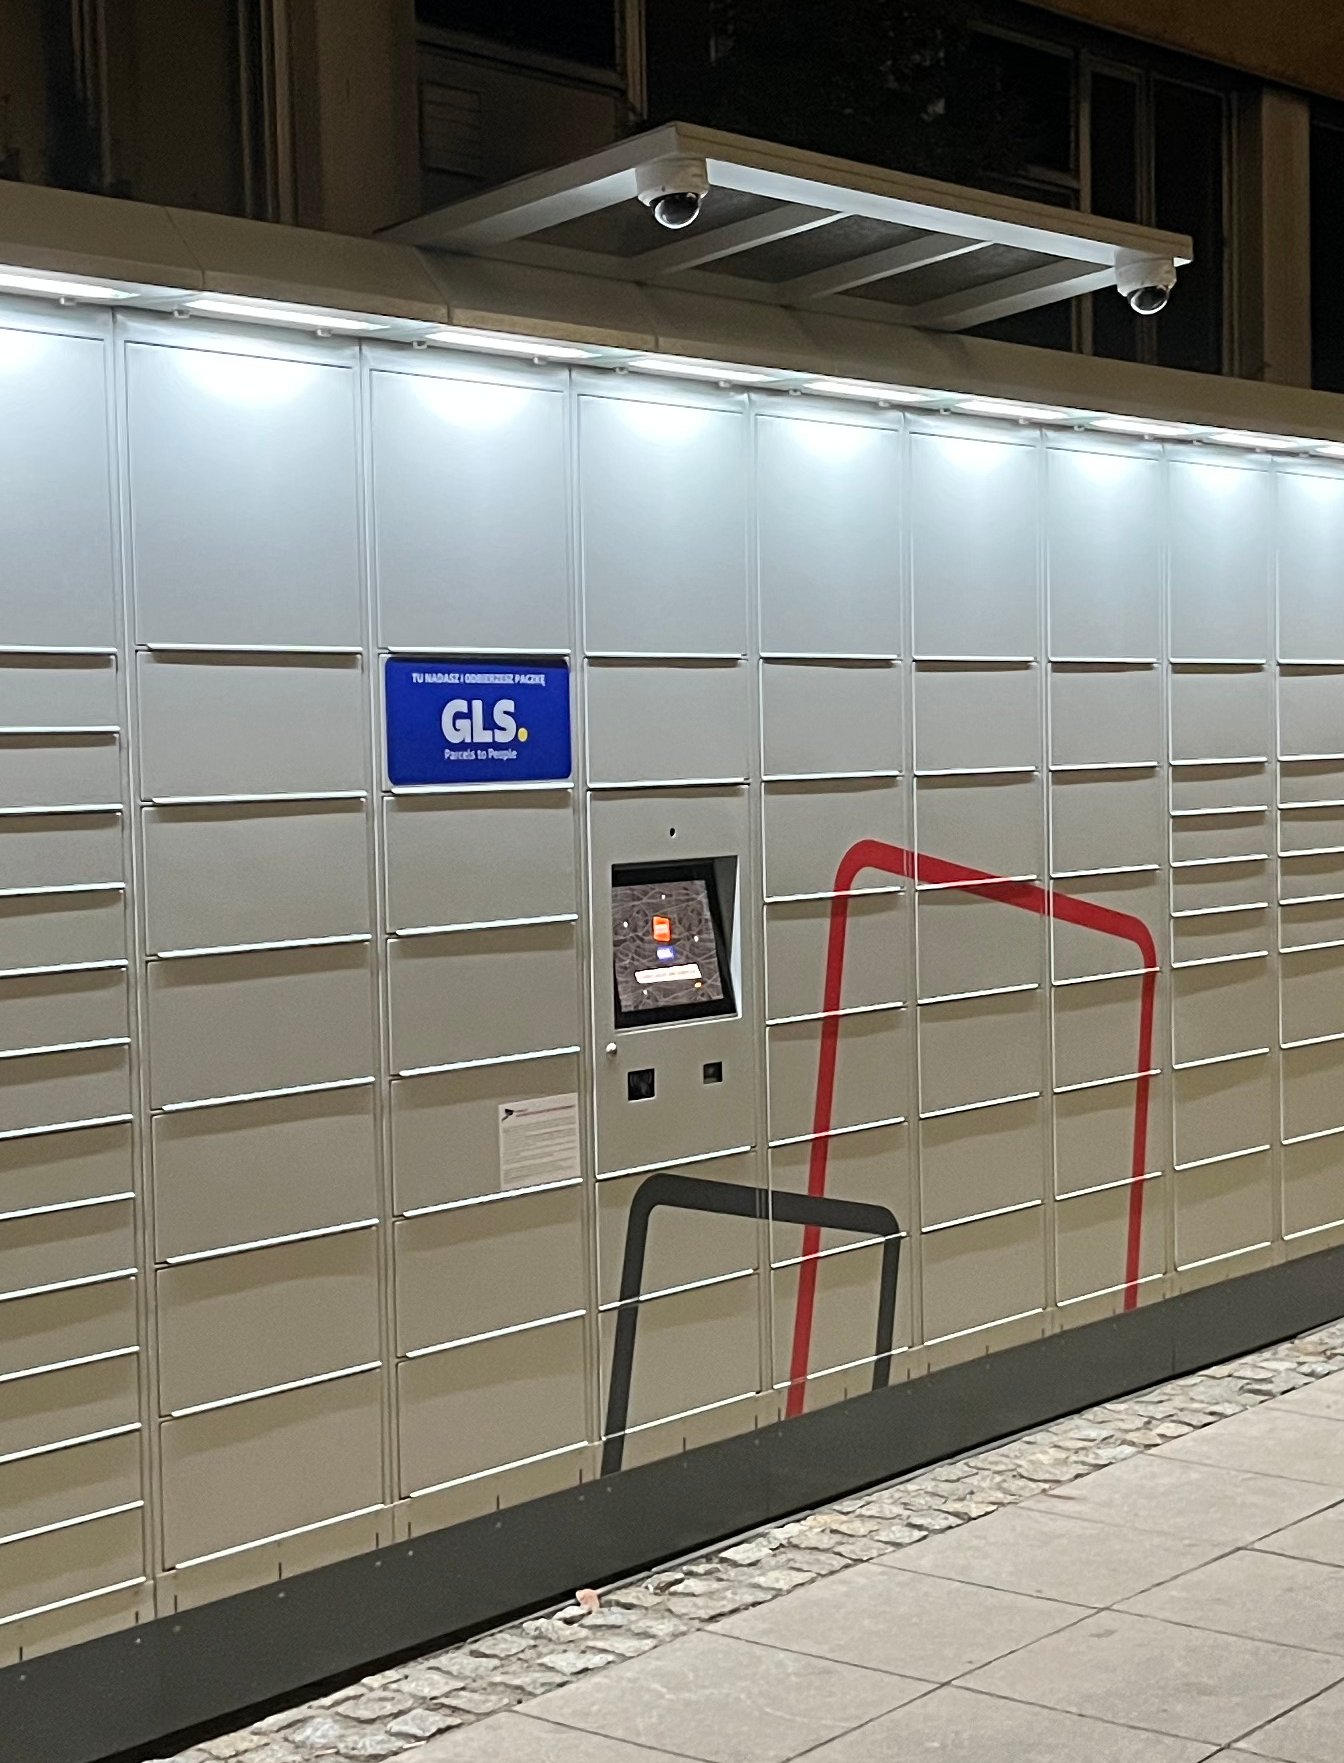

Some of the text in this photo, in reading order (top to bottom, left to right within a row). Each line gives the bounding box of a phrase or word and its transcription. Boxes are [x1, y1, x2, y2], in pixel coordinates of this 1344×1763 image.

[412, 673, 424, 683] TU
[444, 748, 518, 762] Parcels to People
